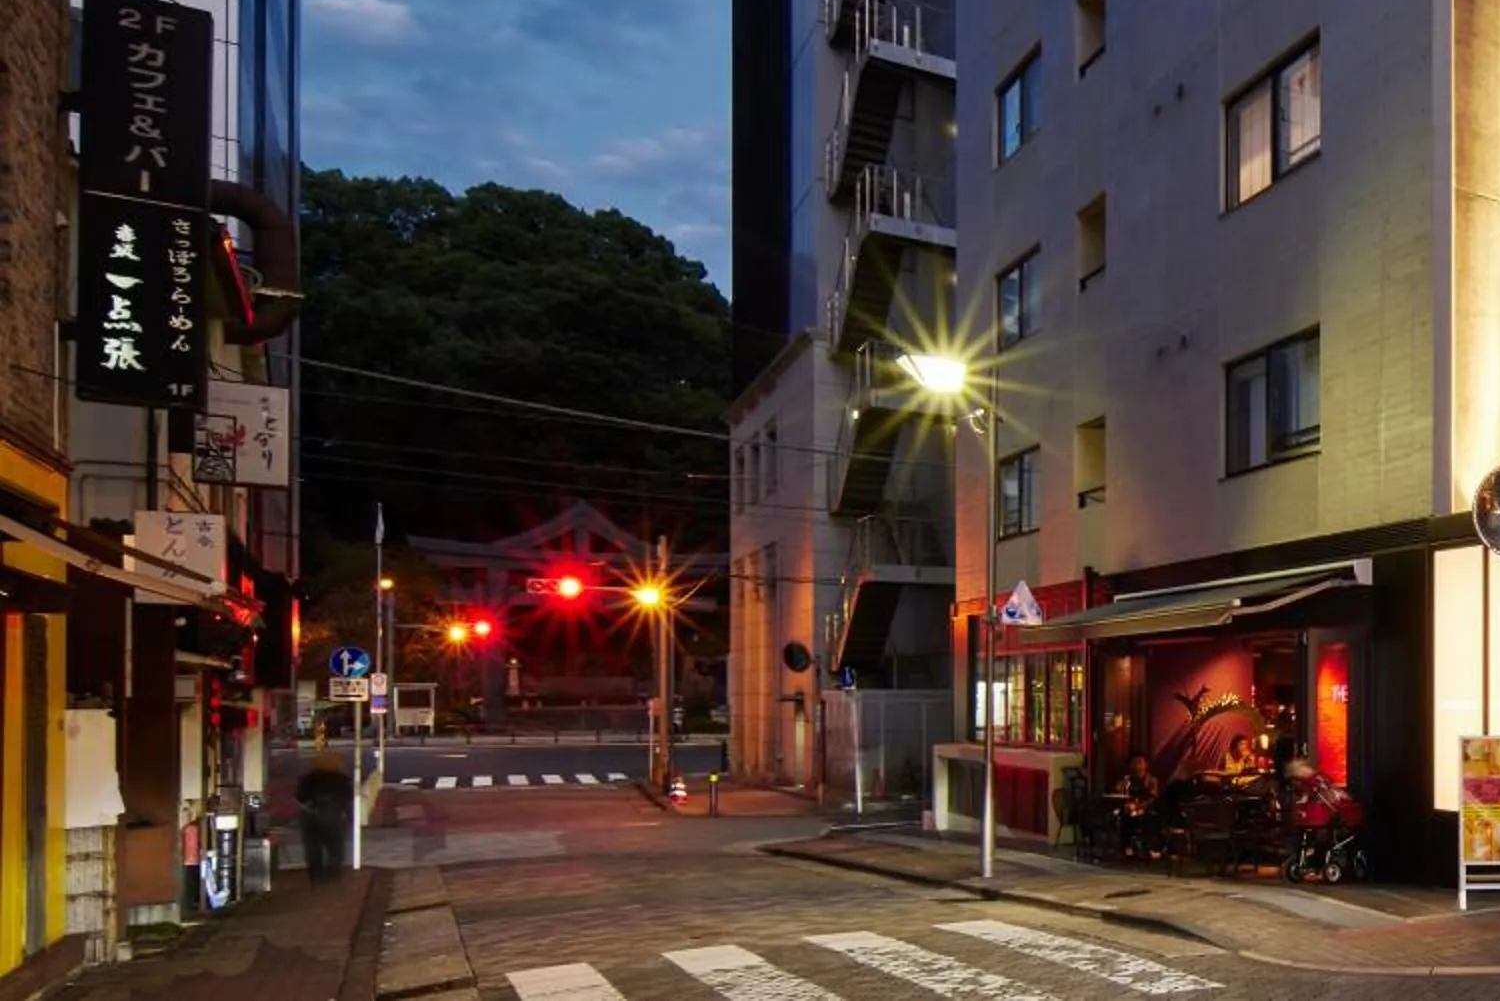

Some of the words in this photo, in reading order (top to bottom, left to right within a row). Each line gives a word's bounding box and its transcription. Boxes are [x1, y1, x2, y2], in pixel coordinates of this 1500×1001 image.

[117, 7, 179, 35] 2F
[125, 42, 168, 193] カフェ&バー
[168, 218, 198, 352] さっぽろらーめん
[167, 383, 194, 396] 1F
